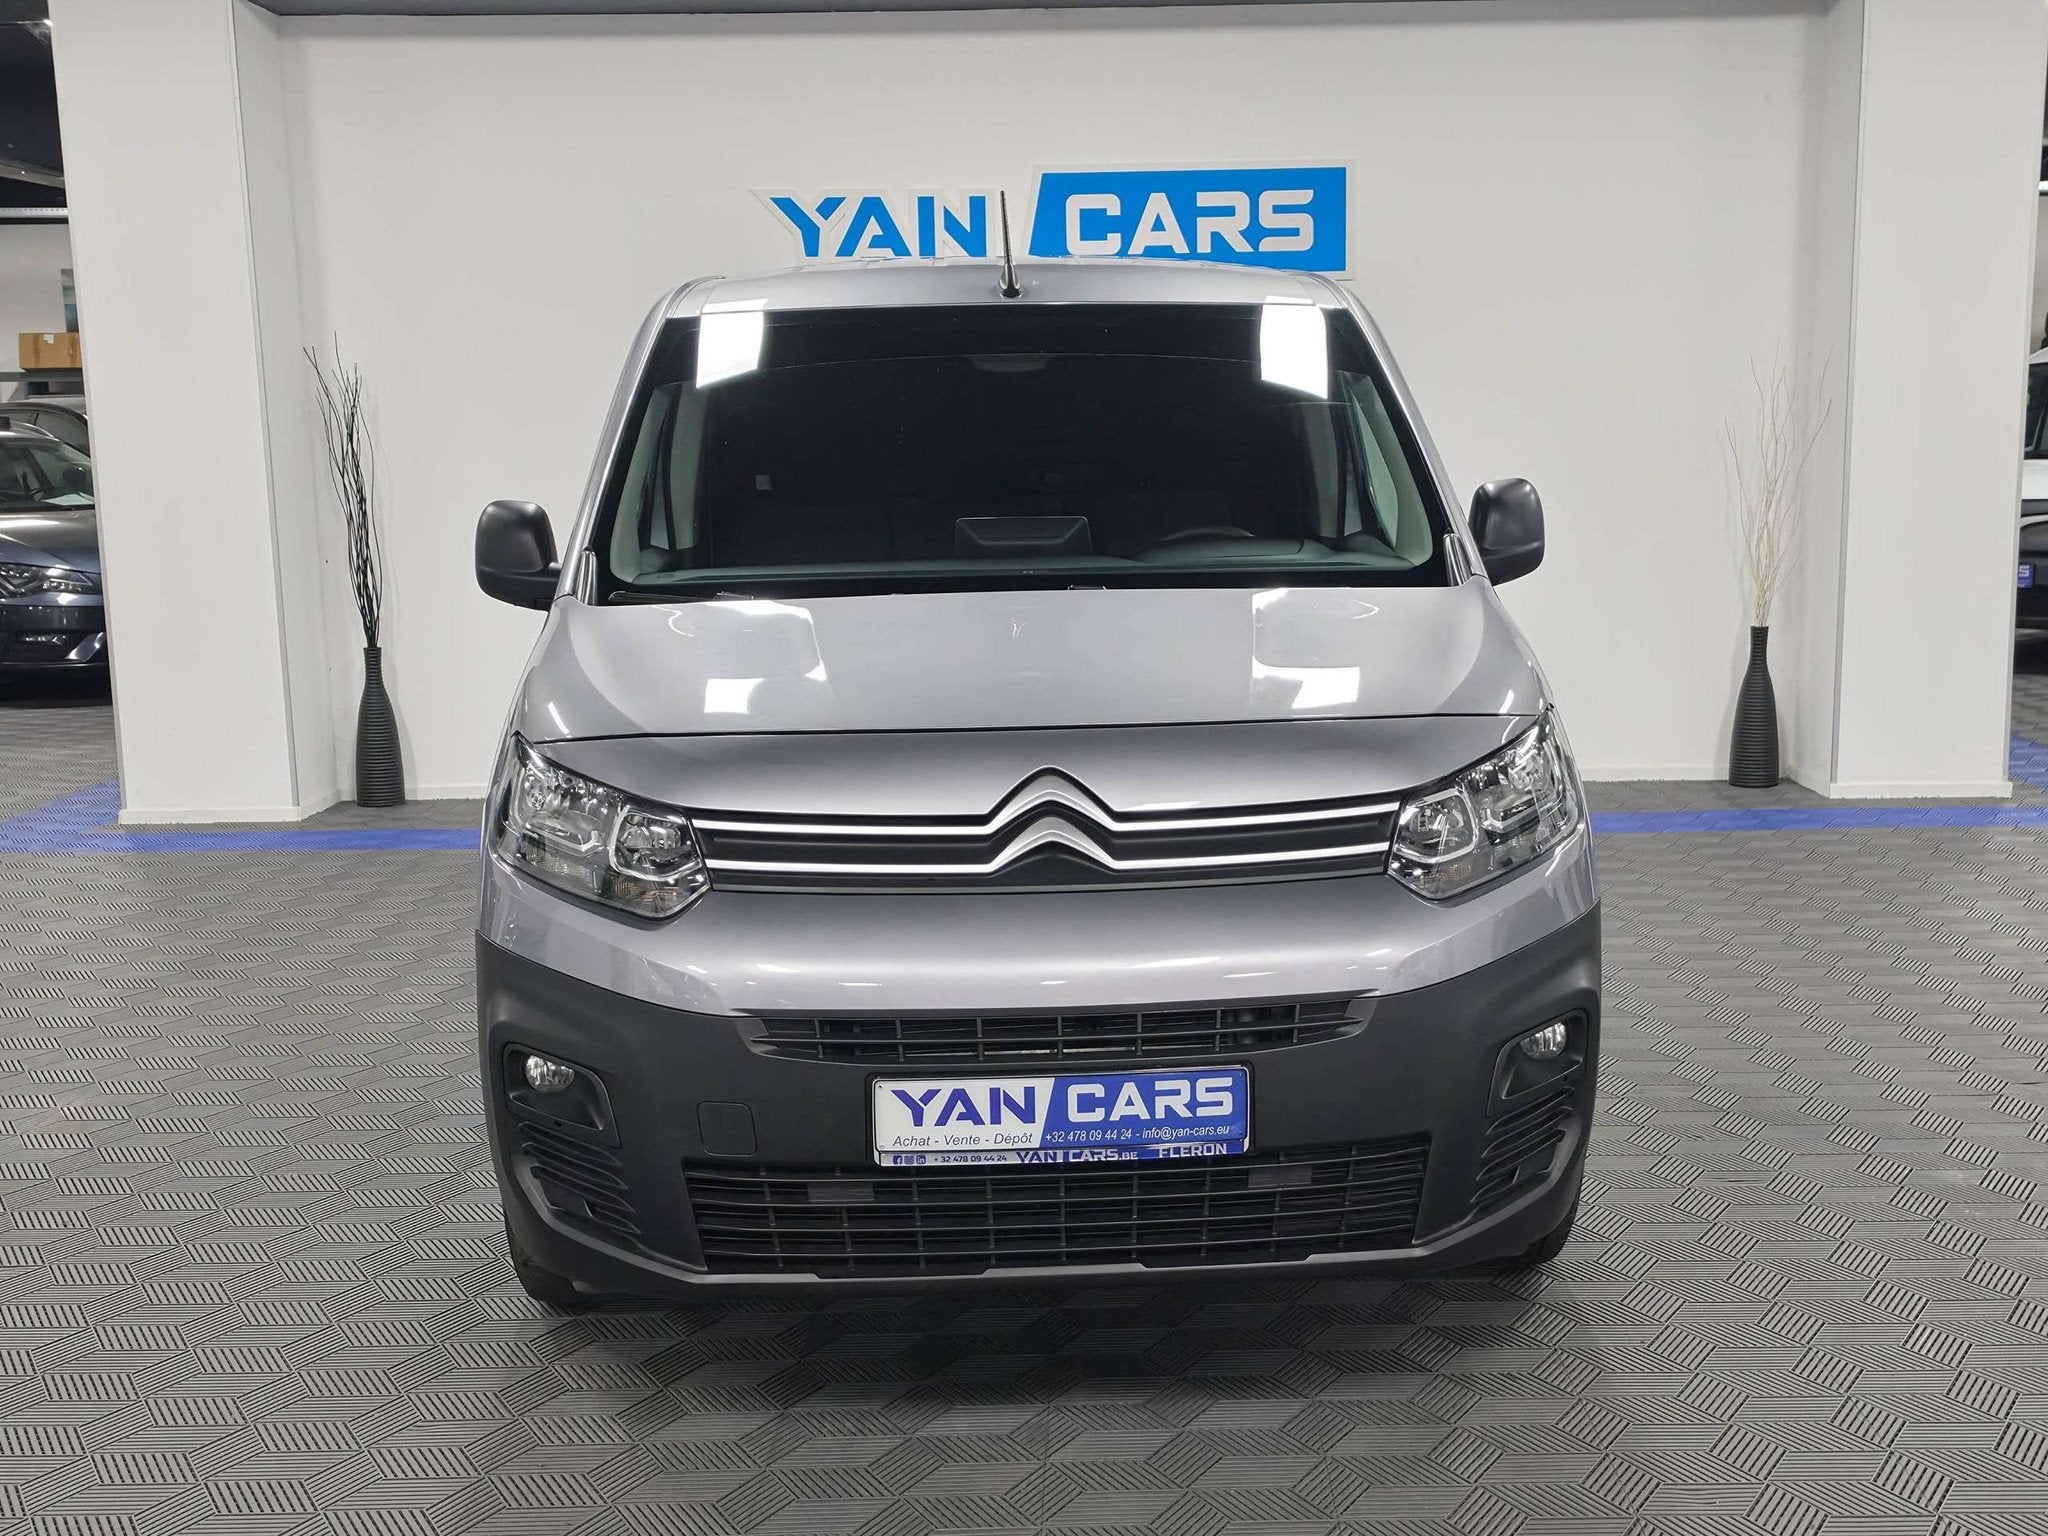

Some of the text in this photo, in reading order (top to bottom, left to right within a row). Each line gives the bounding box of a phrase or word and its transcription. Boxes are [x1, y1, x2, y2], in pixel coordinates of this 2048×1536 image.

[769, 188, 1314, 259] YAN CARS
[889, 1077, 1234, 1127] YAN CARS
[892, 1136, 931, 1147] Achat
[944, 1134, 981, 1146] Vente
[993, 1133, 1033, 1146] Dépôt
[1045, 1131, 1064, 1142] +32
[1067, 1130, 1087, 1141] 478
[1089, 1129, 1102, 1141] 09
[1105, 1129, 1117, 1140] 44
[1120, 1128, 1132, 1139] 24
[1142, 1125, 1230, 1139] info@yan-cars.eu
[1015, 1150, 1058, 1163] YAN
[1158, 1143, 1228, 1158] FLERON
[940, 1155, 951, 1163] 32
[952, 1155, 968, 1163] 478
[970, 1155, 982, 1163] 09
[983, 1154, 995, 1163] 44
[996, 1154, 1008, 1162] 24
